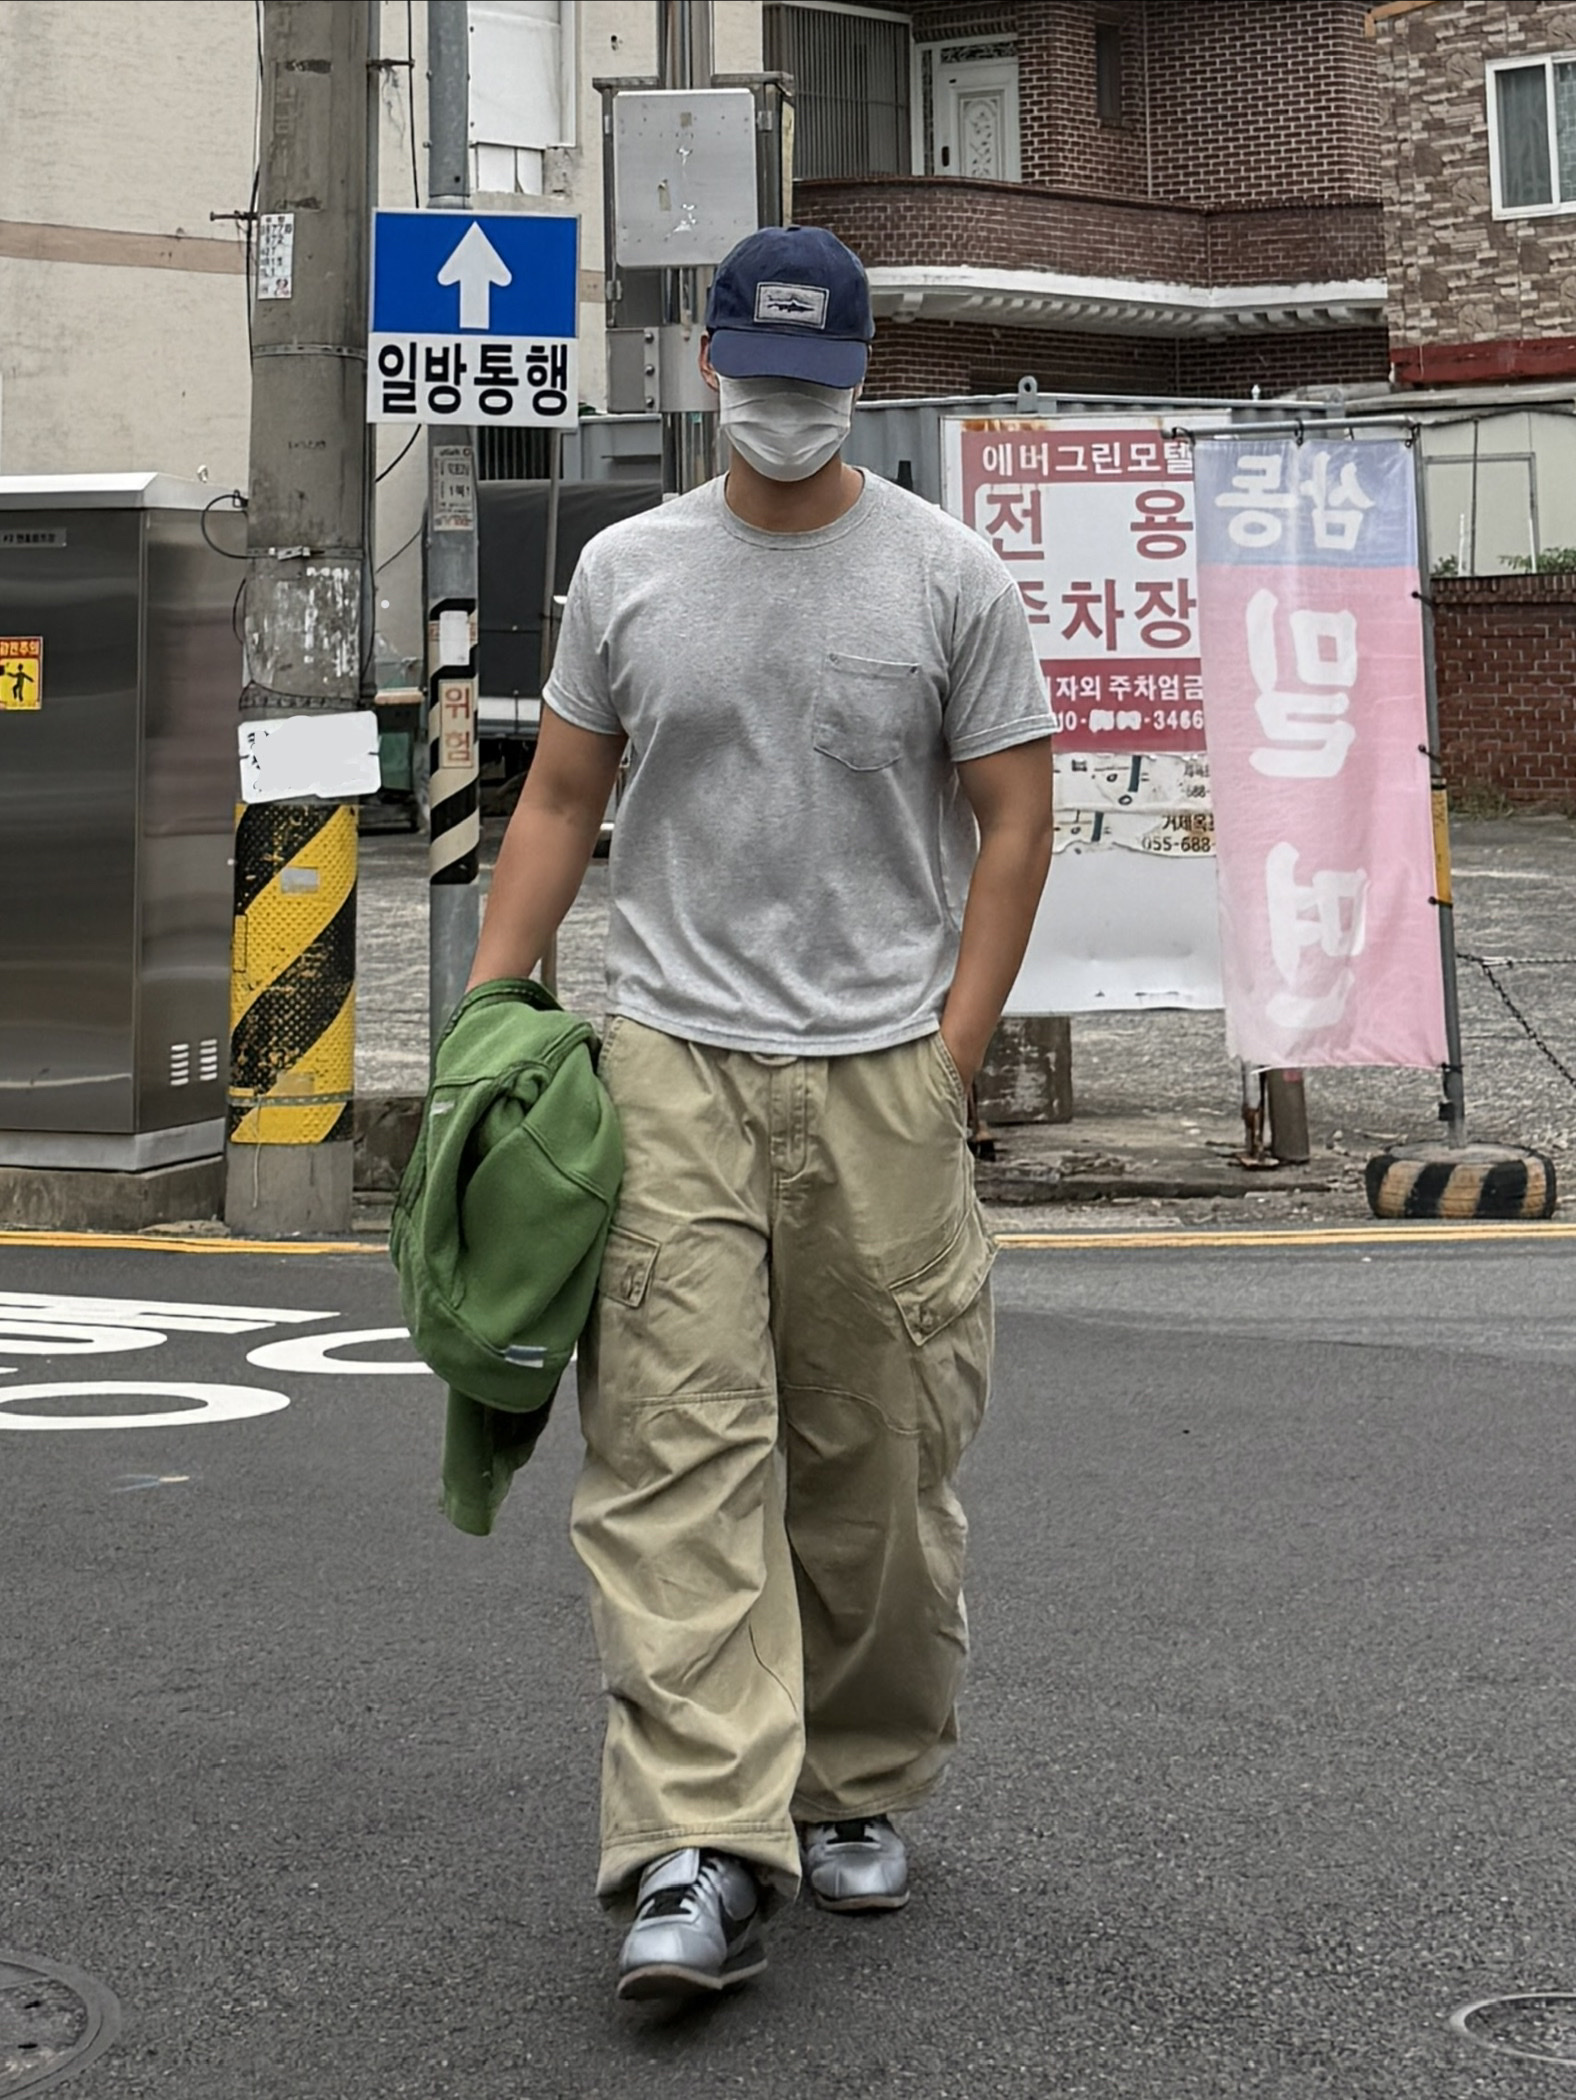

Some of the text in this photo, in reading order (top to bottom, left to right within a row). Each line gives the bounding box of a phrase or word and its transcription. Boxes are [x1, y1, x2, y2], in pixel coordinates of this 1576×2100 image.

[378, 342, 568, 416] 일방통행
[1046, 674, 1204, 702] 자외 주차엄금
